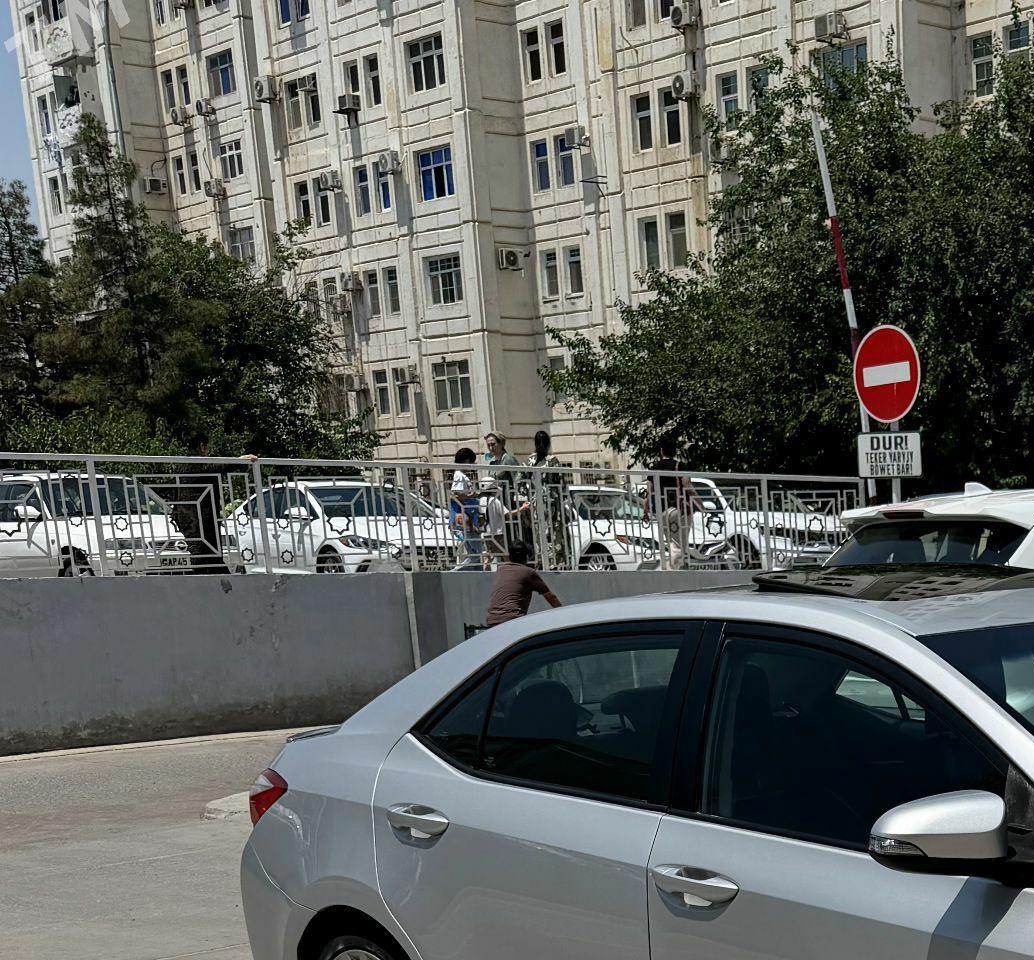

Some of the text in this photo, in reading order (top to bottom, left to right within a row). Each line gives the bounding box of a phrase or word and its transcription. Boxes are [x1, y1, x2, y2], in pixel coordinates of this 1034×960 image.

[870, 435, 908, 450] DUR!
[865, 452, 887, 463] TEKER
[896, 463, 913, 475] BAR!
